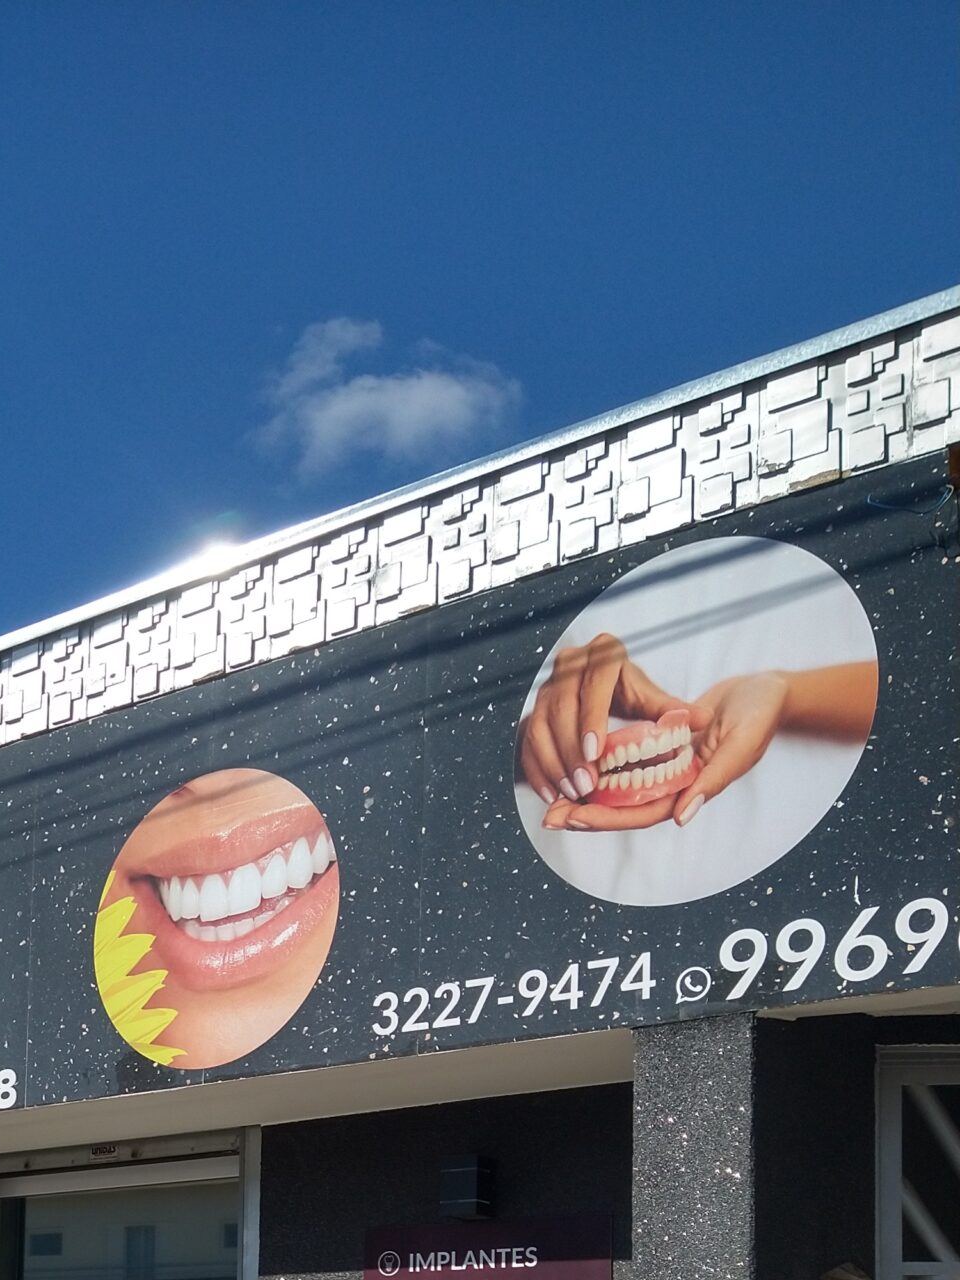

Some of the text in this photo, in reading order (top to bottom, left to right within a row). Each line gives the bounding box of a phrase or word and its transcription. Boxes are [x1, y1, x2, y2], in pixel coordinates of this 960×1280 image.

[371, 897, 960, 1036] 3227-9474 9969
[408, 1247, 538, 1272] IMPLANTES
